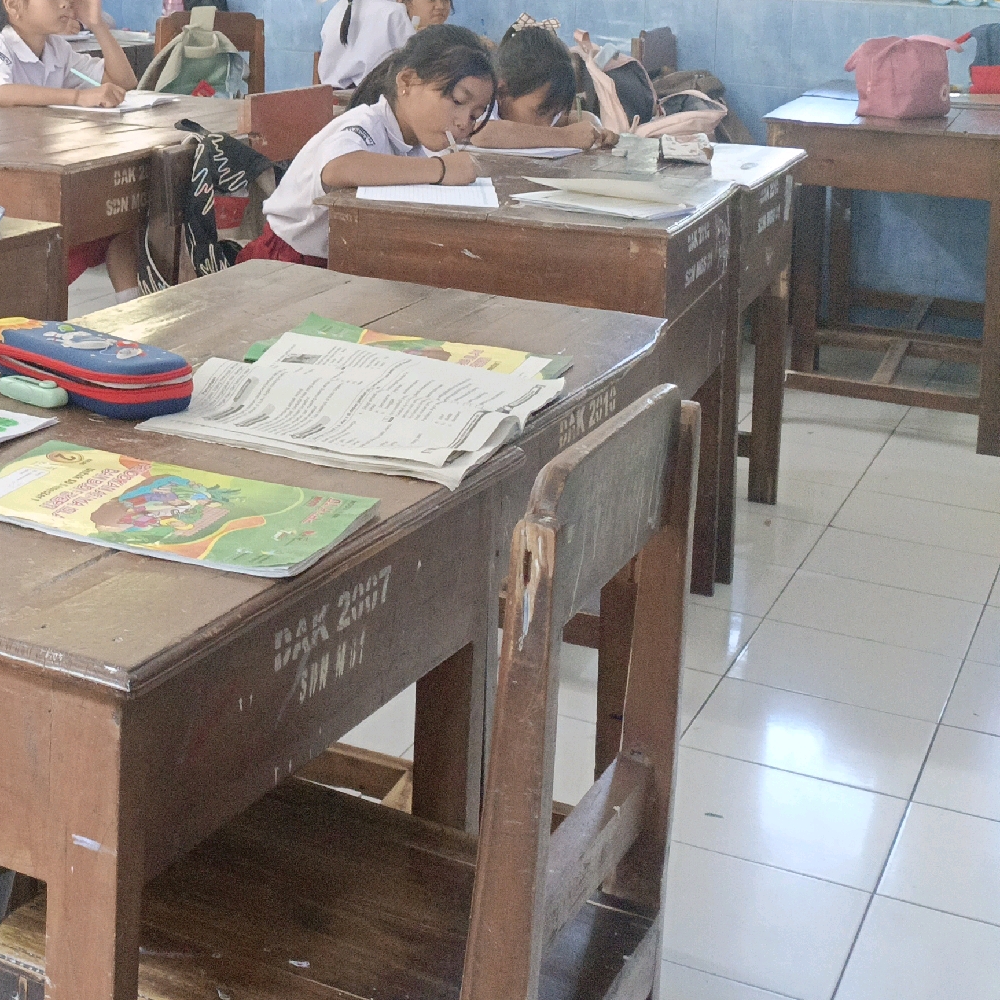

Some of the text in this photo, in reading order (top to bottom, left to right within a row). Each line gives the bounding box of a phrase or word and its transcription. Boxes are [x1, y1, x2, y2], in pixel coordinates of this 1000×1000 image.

[114, 166, 136, 186] DAK
[559, 406, 585, 448] DAK
[54, 452, 76, 461] 2
[274, 565, 392, 672] DAK 2007
